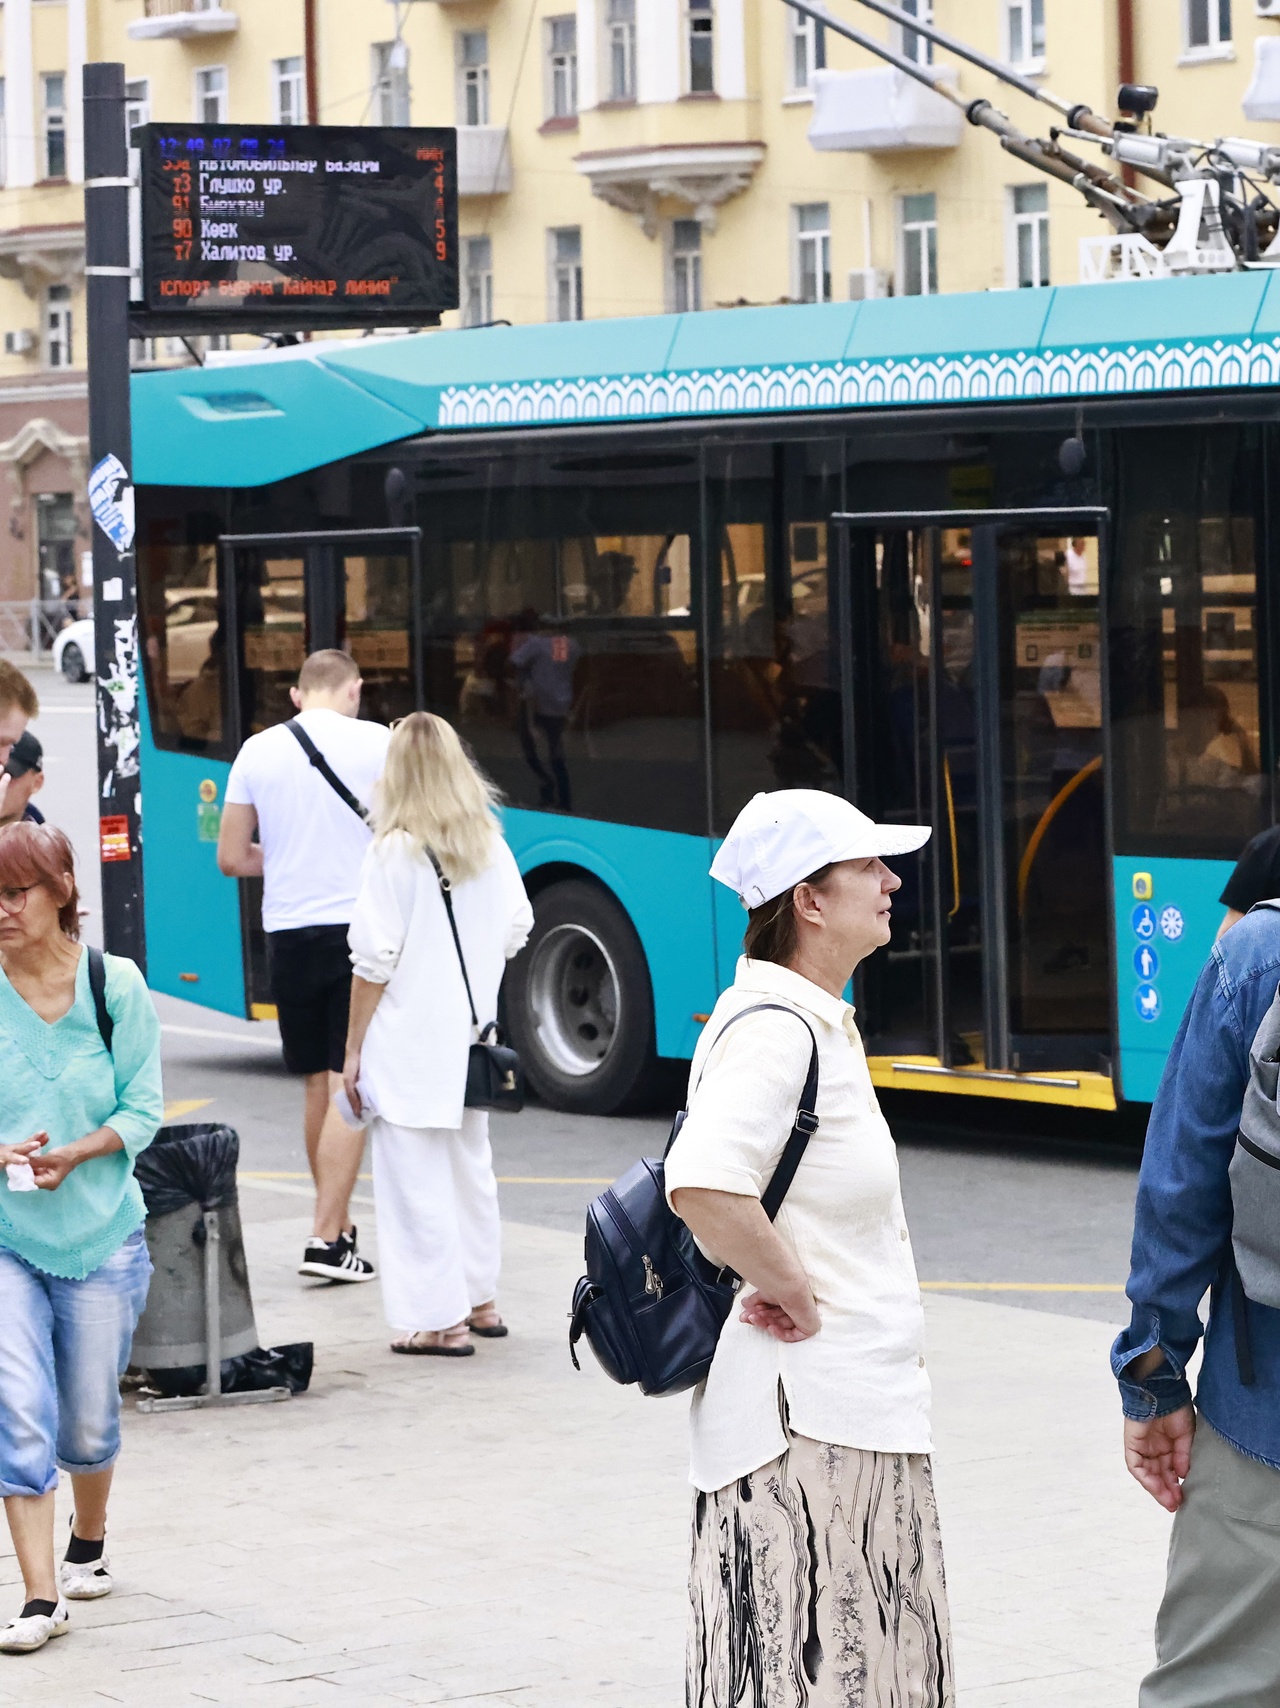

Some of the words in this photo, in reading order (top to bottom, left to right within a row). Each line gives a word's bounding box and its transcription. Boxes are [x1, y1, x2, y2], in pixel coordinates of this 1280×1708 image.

[199, 173, 255, 194] Глушко
[434, 219, 446, 239] 5
[201, 241, 266, 261] Халитов
[436, 240, 447, 261] 9
